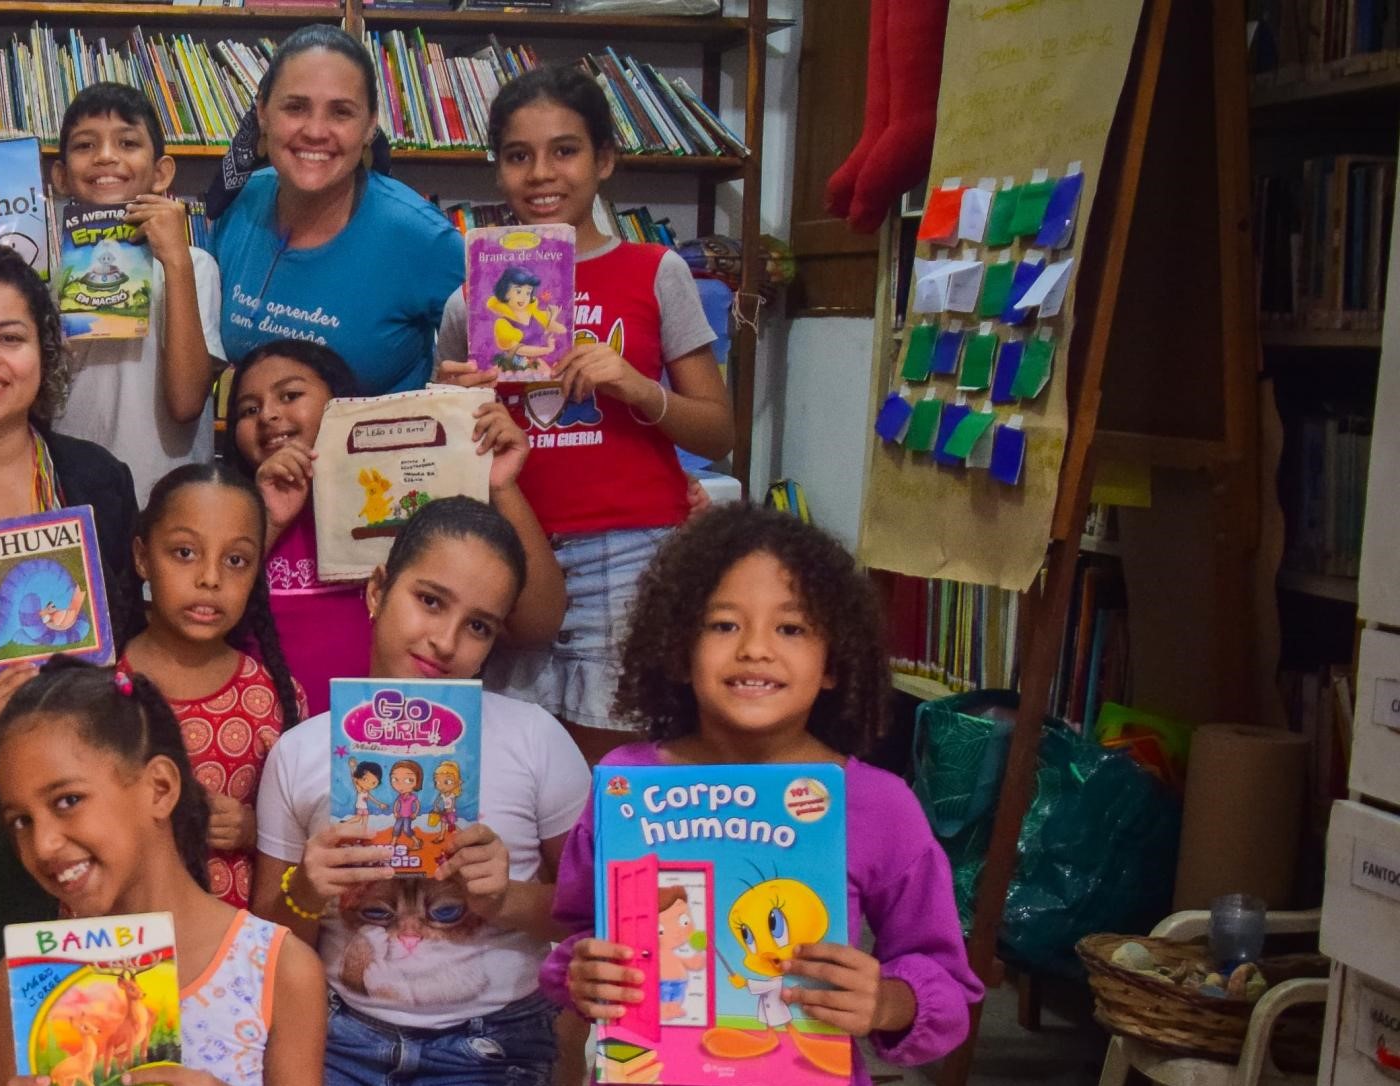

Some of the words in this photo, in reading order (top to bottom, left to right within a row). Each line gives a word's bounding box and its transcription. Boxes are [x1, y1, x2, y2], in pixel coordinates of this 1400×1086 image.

[65, 216, 80, 229] AS
[82, 209, 127, 223] AVENTUR
[479, 251, 515, 262] Branca
[518, 248, 532, 260] de
[535, 248, 563, 261] Neve
[266, 300, 340, 328] aprender
[536, 433, 555, 448] EM
[556, 430, 603, 447] GUERRA
[372, 688, 432, 723] GO
[363, 717, 442, 745] GIRL!
[643, 783, 757, 813] Corpo
[641, 816, 796, 848] humano
[36, 926, 145, 955] BAMBI
